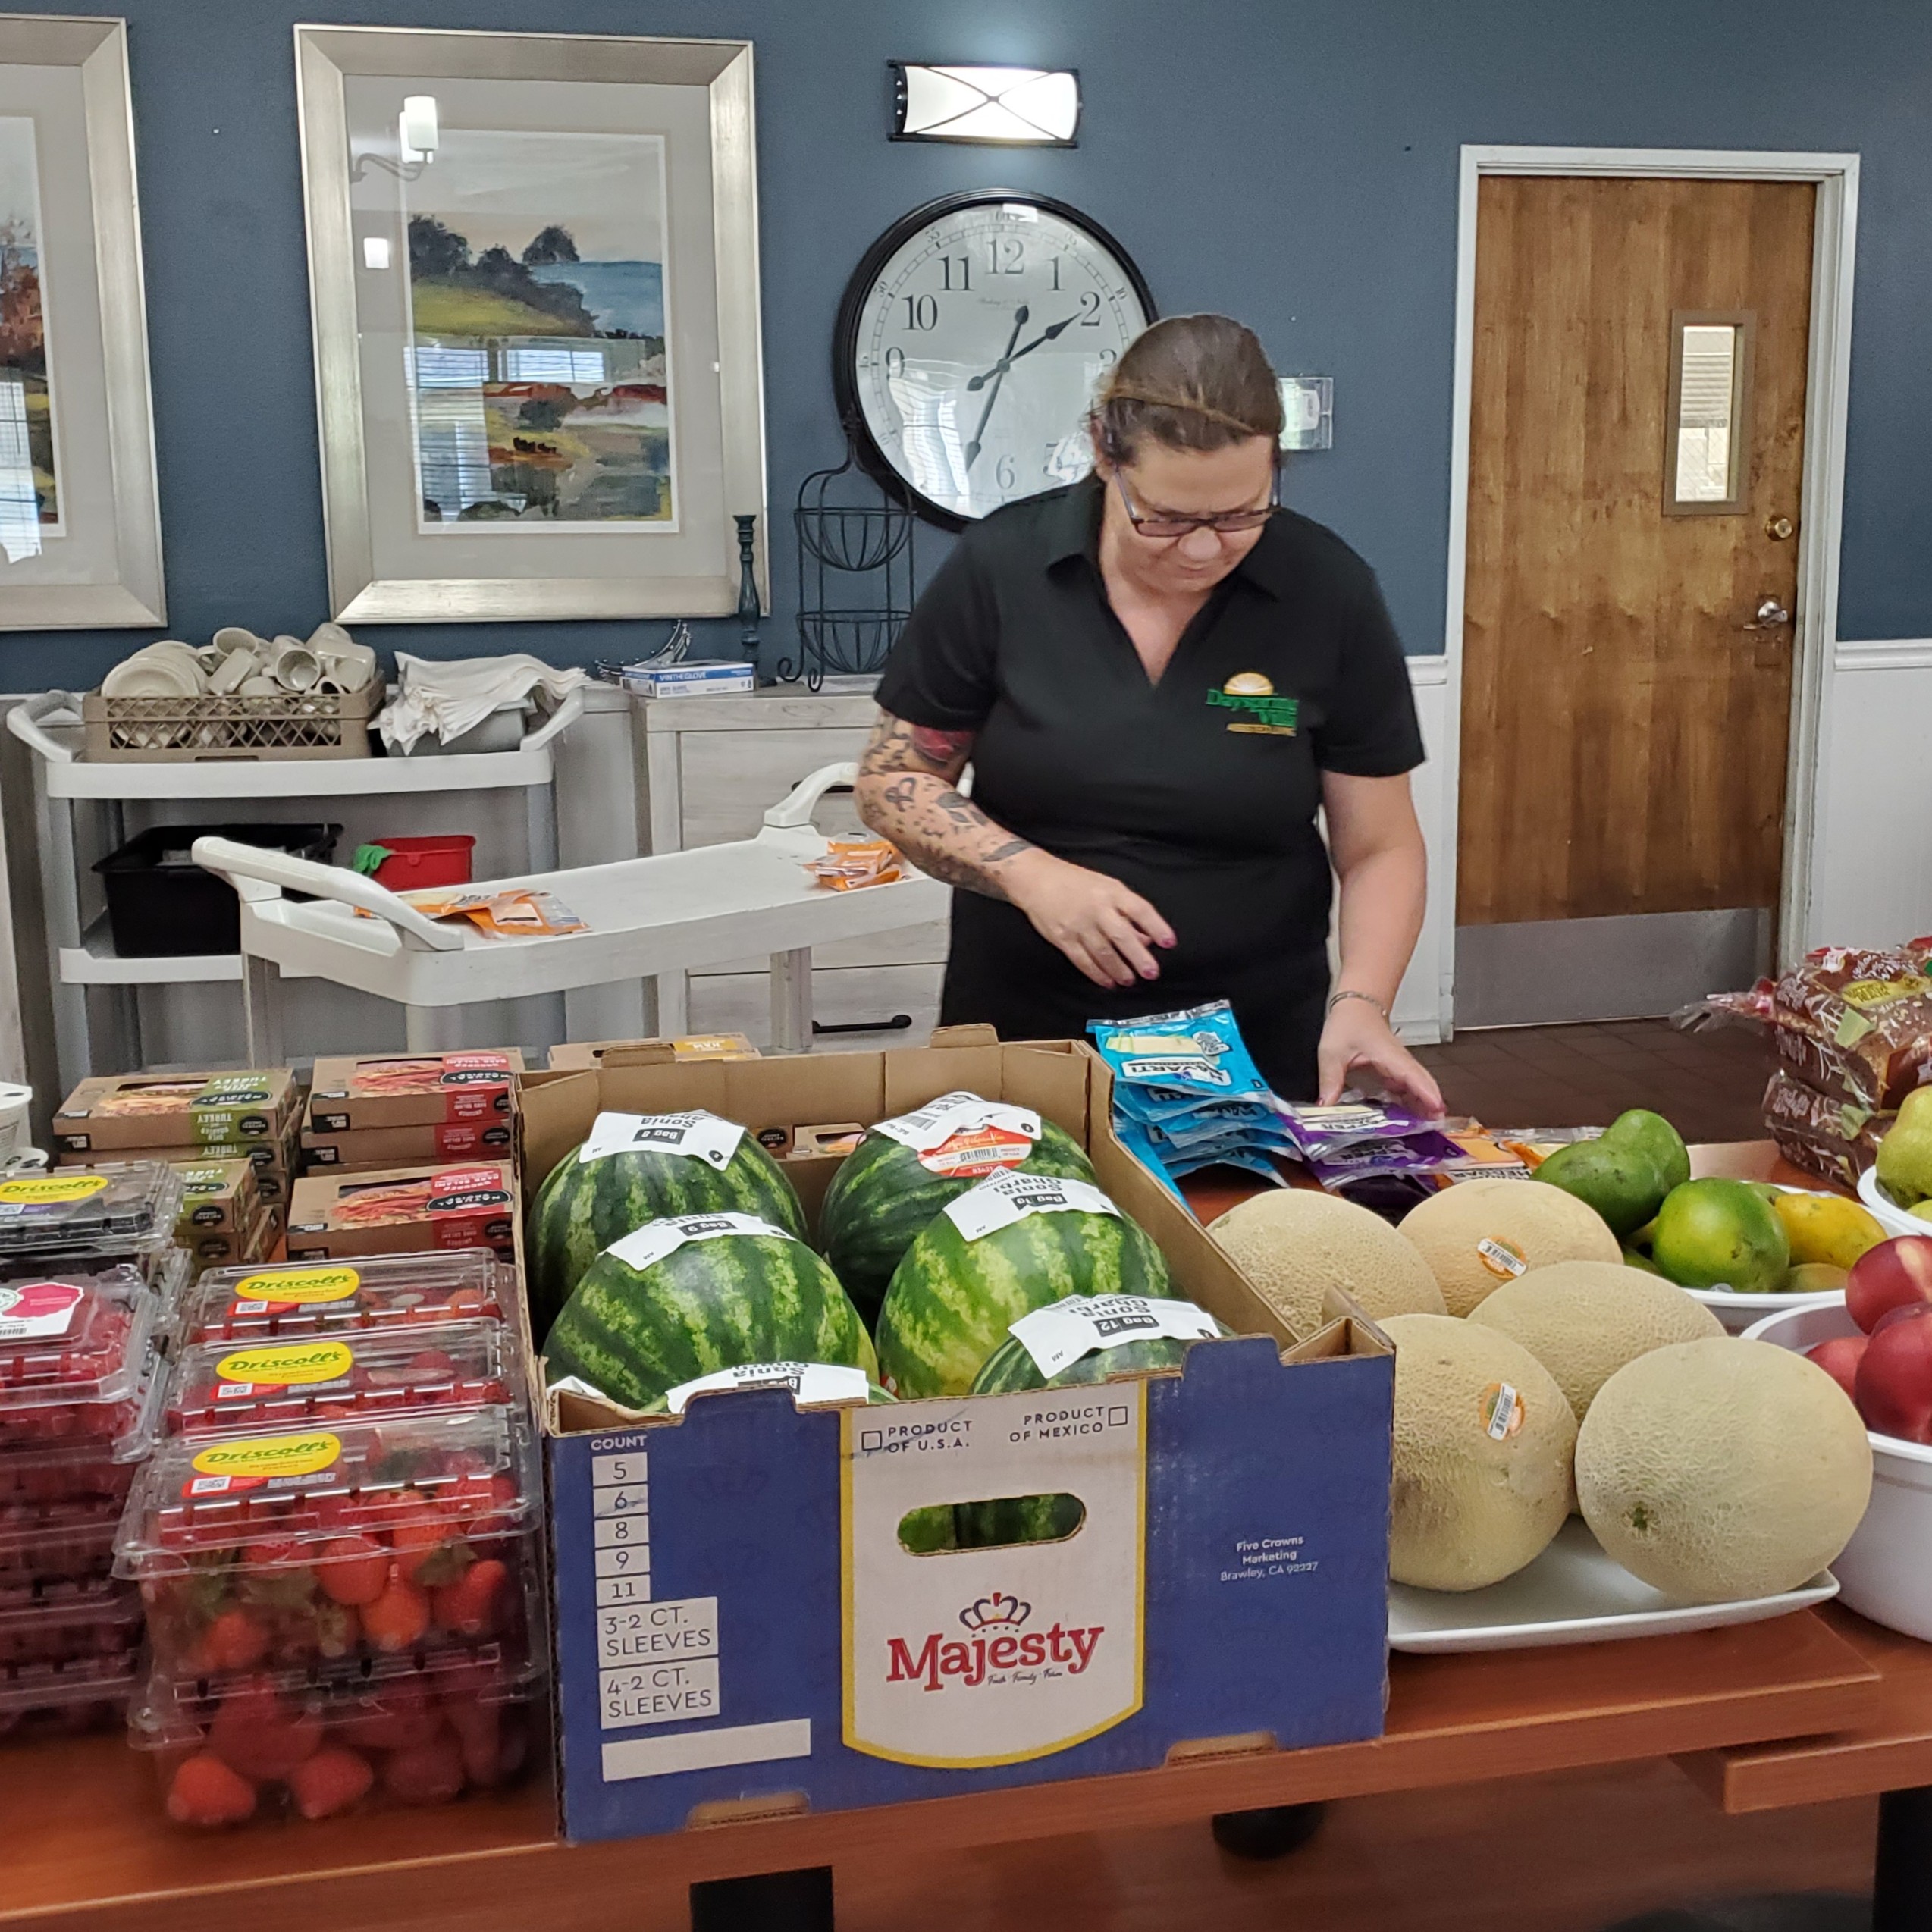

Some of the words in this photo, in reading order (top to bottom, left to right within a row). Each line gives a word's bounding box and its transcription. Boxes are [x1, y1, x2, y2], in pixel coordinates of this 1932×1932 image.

[926, 227, 941, 243] 55
[986, 239, 1024, 274] 12
[938, 256, 974, 291] 11
[1046, 256, 1065, 291] 1
[902, 295, 938, 331] 10
[1080, 292, 1101, 326] 2
[996, 455, 1015, 490] 6
[197, 1113, 232, 1123] TURKEY
[641, 1117, 696, 1128] Sonia
[654, 1130, 679, 1140] Bag
[202, 1144, 237, 1156] TURKEY
[1451, 1169, 1531, 1178] HEDDAR
[993, 1178, 1062, 1193] Gharbi
[1002, 1184, 1063, 1196] Sonia
[1069, 1299, 1148, 1314] Gharbi
[1081, 1306, 1152, 1318] Sonia
[1100, 1321, 1120, 1331] 12
[1123, 1316, 1154, 1324] Bag
[228, 1351, 343, 1370] Driscoll's
[1051, 1350, 1065, 1363] AM
[732, 1367, 805, 1378] Sonia
[1024, 1406, 1106, 1425] PRODUCT
[888, 1419, 973, 1438] PRODUCT
[1009, 1430, 1032, 1443] OF
[1038, 1422, 1104, 1441] MEXICO
[205, 1441, 334, 1463] Driscoll's
[591, 1435, 647, 1451] COUNT
[888, 1442, 911, 1454] OF
[917, 1438, 971, 1451] U.S.A.
[613, 1461, 627, 1480] 5
[614, 1491, 628, 1510] 6
[615, 1521, 629, 1539] 8
[1236, 1540, 1259, 1552] Five
[1262, 1536, 1304, 1548] Crowns
[615, 1551, 629, 1570] 9
[1242, 1550, 1297, 1565] Marketing
[1220, 1567, 1266, 1582] Brawley,
[1269, 1565, 1284, 1576] CA
[1287, 1561, 1319, 1573] 92227
[611, 1582, 636, 1599] 11
[604, 1614, 641, 1636] 3-2
[650, 1605, 688, 1627] CT.
[606, 1628, 711, 1658] SLEEVES
[886, 1622, 1105, 1692] Majesty
[607, 1675, 644, 1695] 4-2
[652, 1667, 690, 1689] CT.
[608, 1689, 713, 1719] SLEEVES
